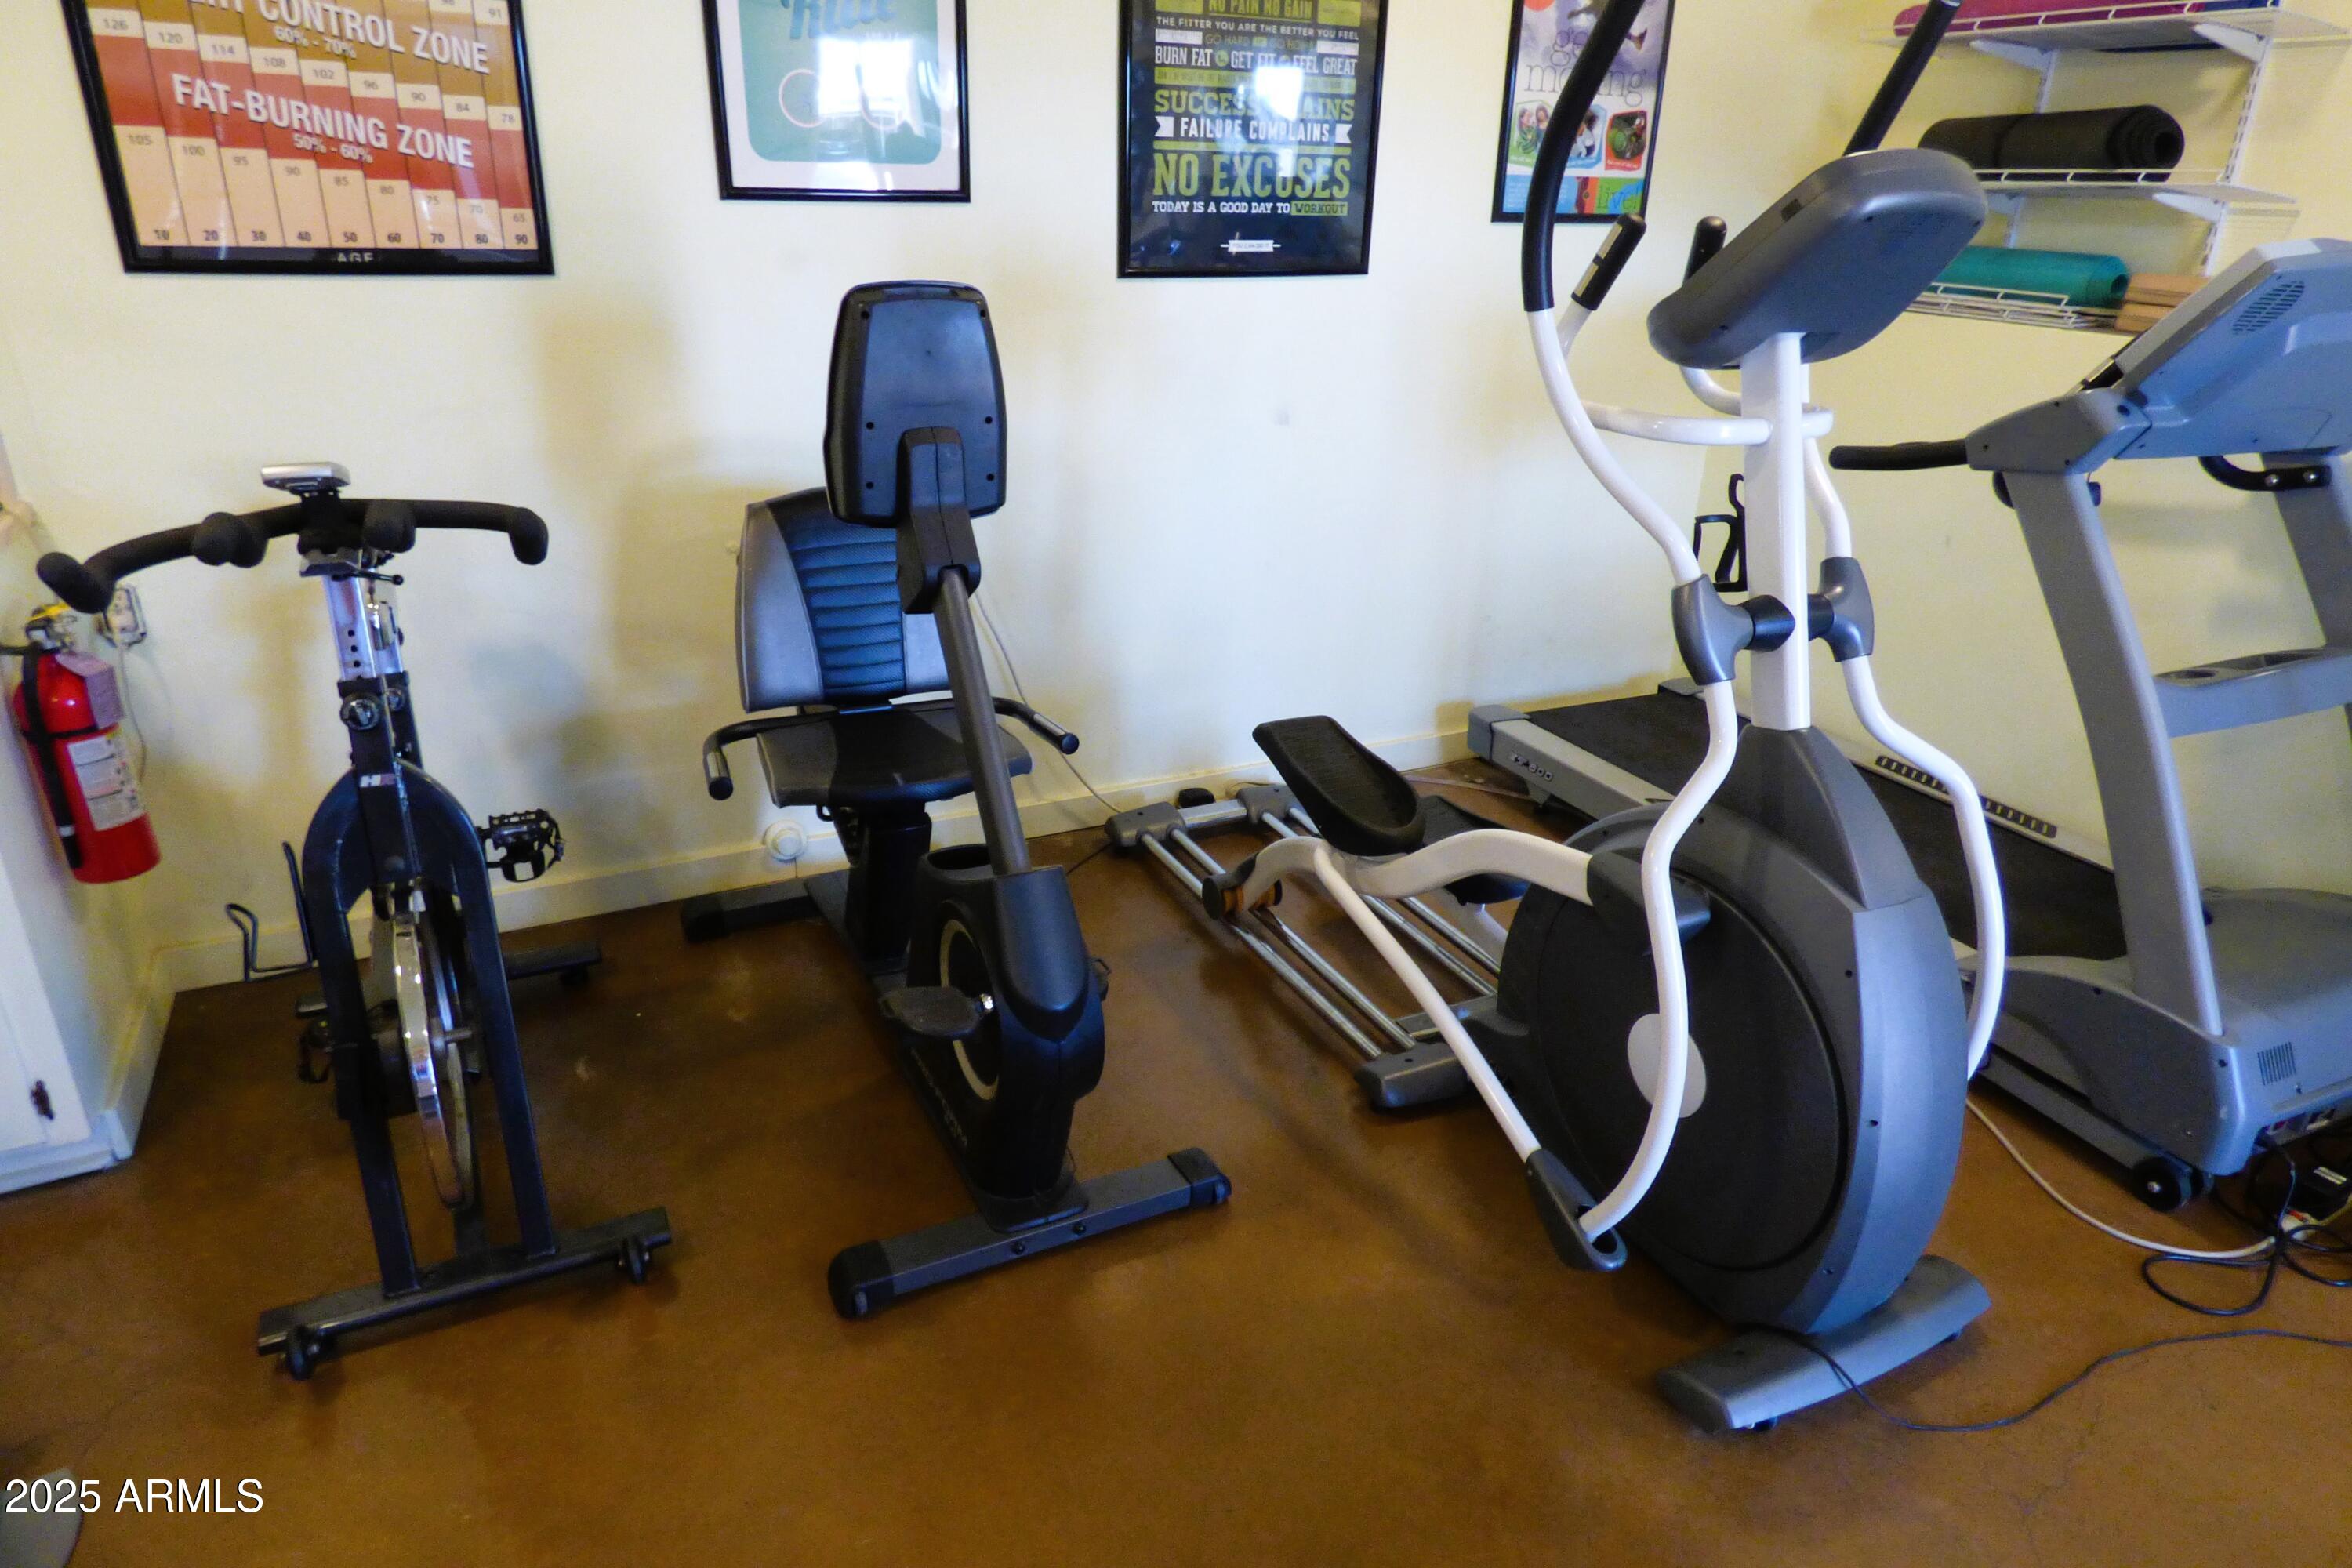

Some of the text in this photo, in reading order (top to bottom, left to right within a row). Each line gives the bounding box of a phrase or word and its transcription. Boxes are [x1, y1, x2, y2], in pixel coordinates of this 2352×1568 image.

[257, 0, 491, 74] CONTROL ZONE
[1156, 16, 1359, 40] THE FITTER YOU ARE THE BETTER YOU FEEL
[313, 69, 334, 79] 102
[1155, 45, 1188, 65] BURN
[1192, 48, 1214, 67] FAT
[1230, 50, 1254, 69] GET
[1323, 56, 1358, 76] GREAT
[1524, 64, 1646, 107] mong
[172, 72, 475, 168] FAT-BURNING ZONE
[1180, 117, 1330, 142] FAILURE COMPLAINS
[1153, 153, 1351, 198] NO EXCUSES
[1152, 201, 1345, 214] TODAY IS A GOOD DAY TO WORKOUT
[203, 230, 220, 241] 20
[251, 230, 267, 241] 30
[296, 231, 312, 242] 40
[343, 232, 358, 243] 50
[387, 232, 401, 243] 60
[431, 233, 445, 243] 70
[475, 234, 488, 244] 80
[515, 234, 528, 245] 90
